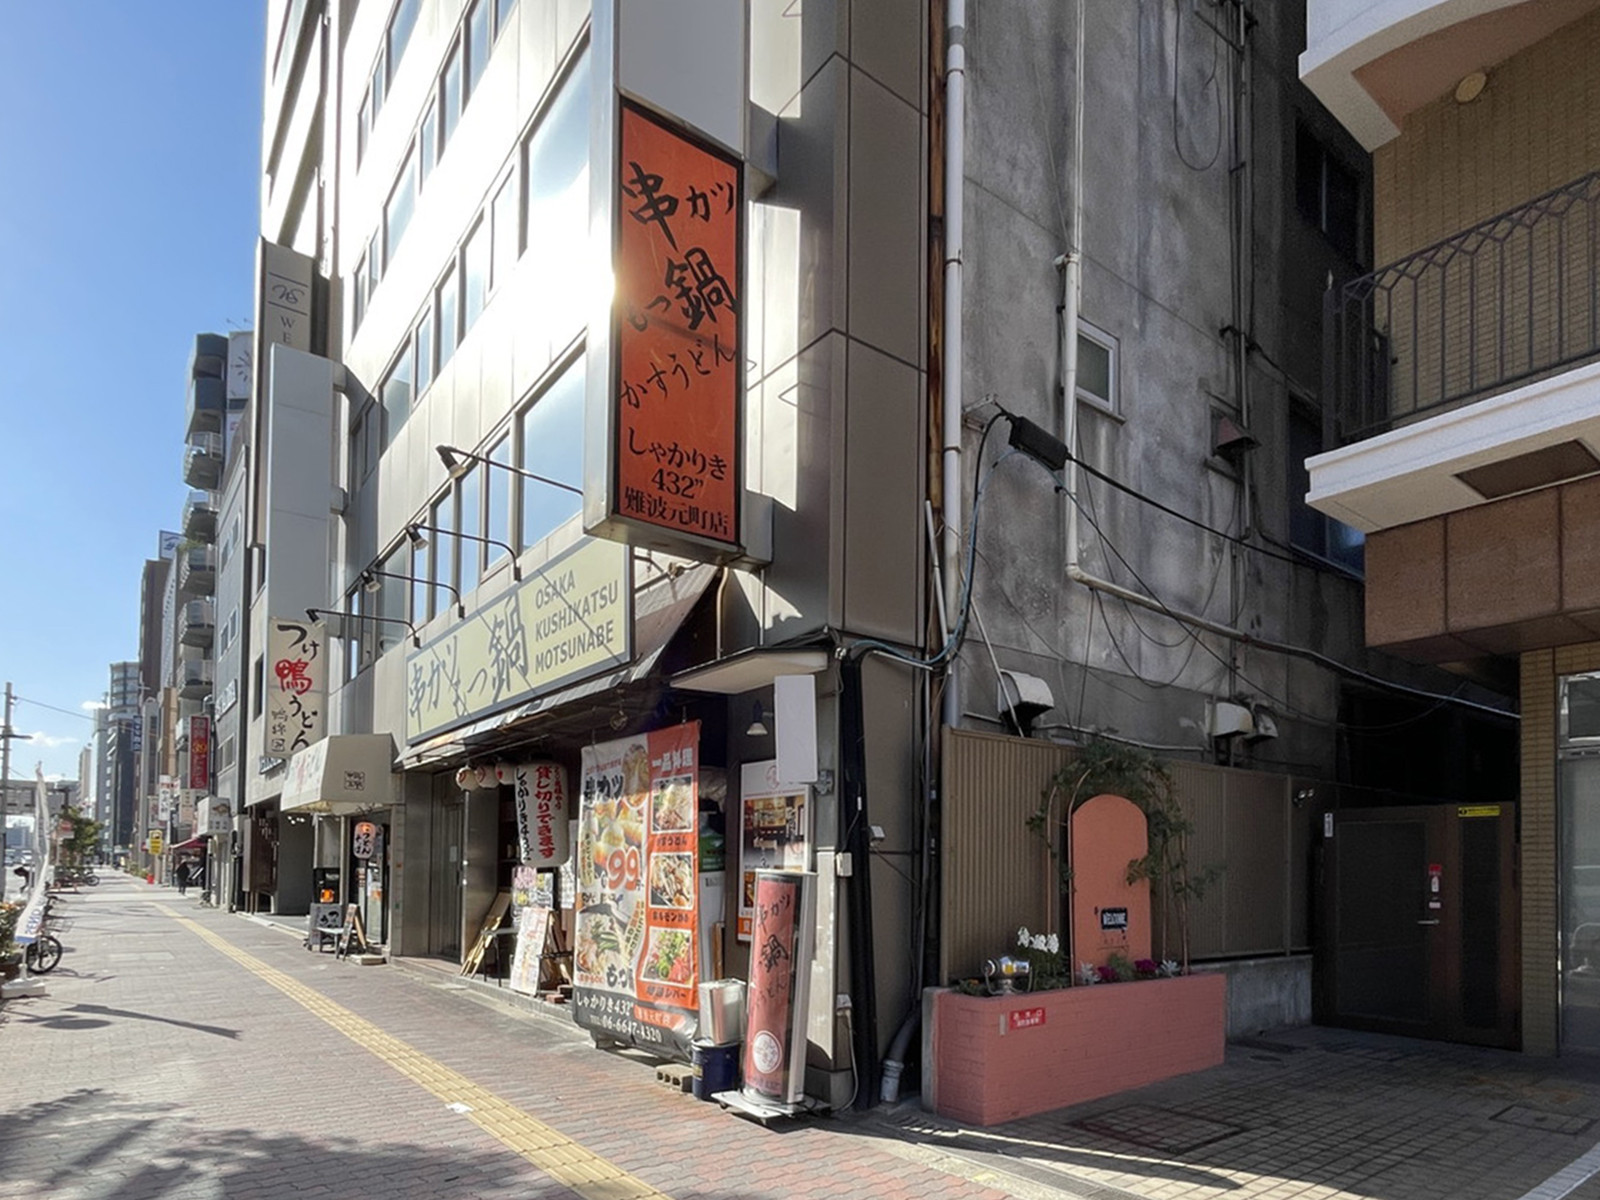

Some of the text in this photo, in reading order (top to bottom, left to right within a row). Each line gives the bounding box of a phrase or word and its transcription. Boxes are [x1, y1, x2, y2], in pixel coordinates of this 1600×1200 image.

[620, 334, 735, 409] かすうどん
[629, 427, 726, 481] しゃかりき
[625, 486, 728, 536] 難波元町店
[535, 569, 575, 609] OSAKA
[535, 580, 618, 642] KUSHIKATSU
[535, 620, 614, 674] MOTSUNABE
[275, 624, 320, 751] つけ鴨うどん
